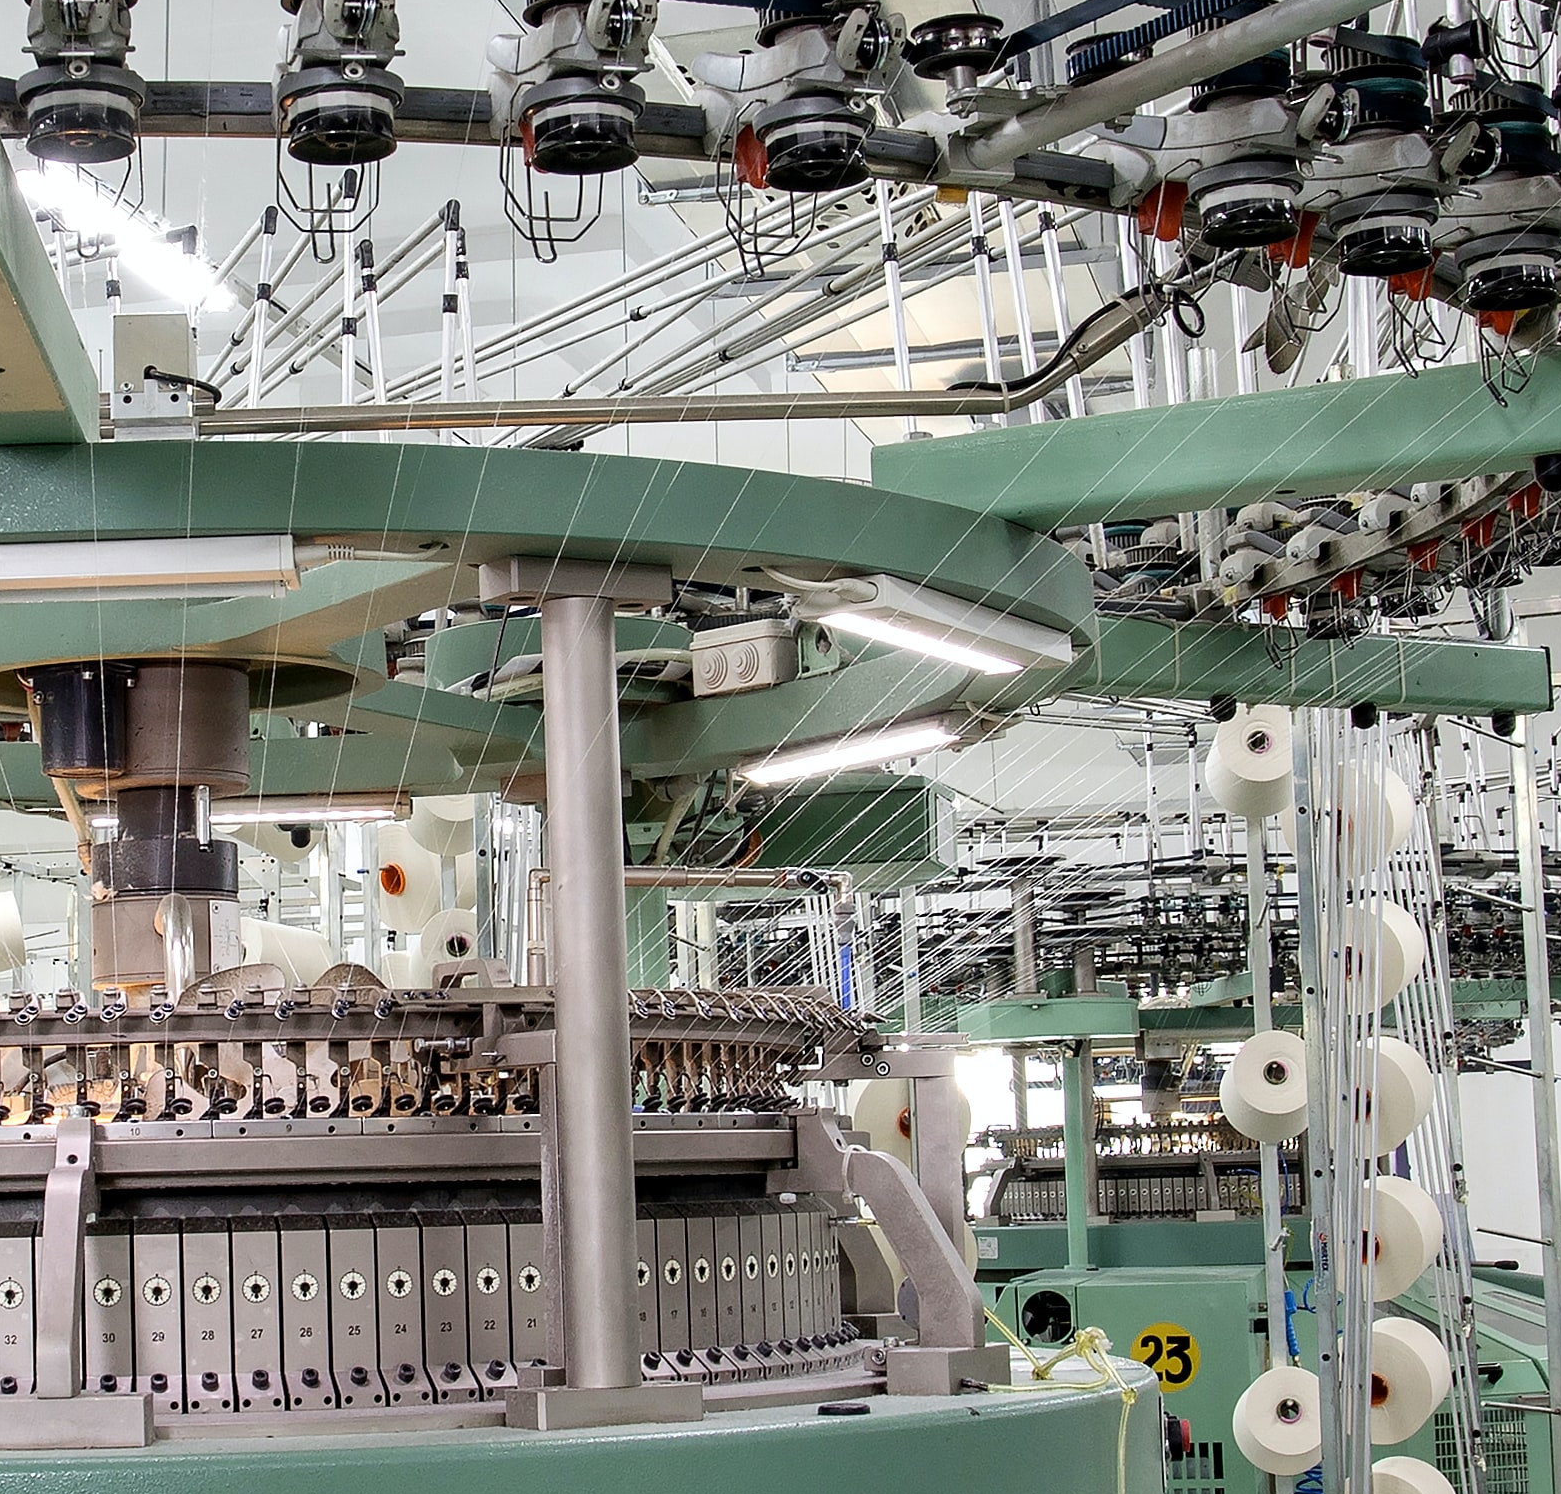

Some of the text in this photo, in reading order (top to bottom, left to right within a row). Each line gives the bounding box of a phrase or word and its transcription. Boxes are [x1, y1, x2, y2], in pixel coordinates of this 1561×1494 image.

[130, 1127, 141, 1137] 10
[286, 1124, 292, 1134] 9
[671, 1310, 679, 1320] 17
[394, 1324, 407, 1335] 24
[440, 1322, 452, 1333] 23
[484, 1320, 496, 1330] 22
[526, 1319, 537, 1329] 21
[201, 1330, 215, 1342] 28
[251, 1328, 264, 1340] 27
[299, 1327, 313, 1338] 26
[348, 1325, 361, 1336] 25
[4, 1334, 18, 1346] 32
[102, 1332, 116, 1344] 30
[152, 1331, 165, 1342] 29
[1140, 1334, 1193, 1384] 23
